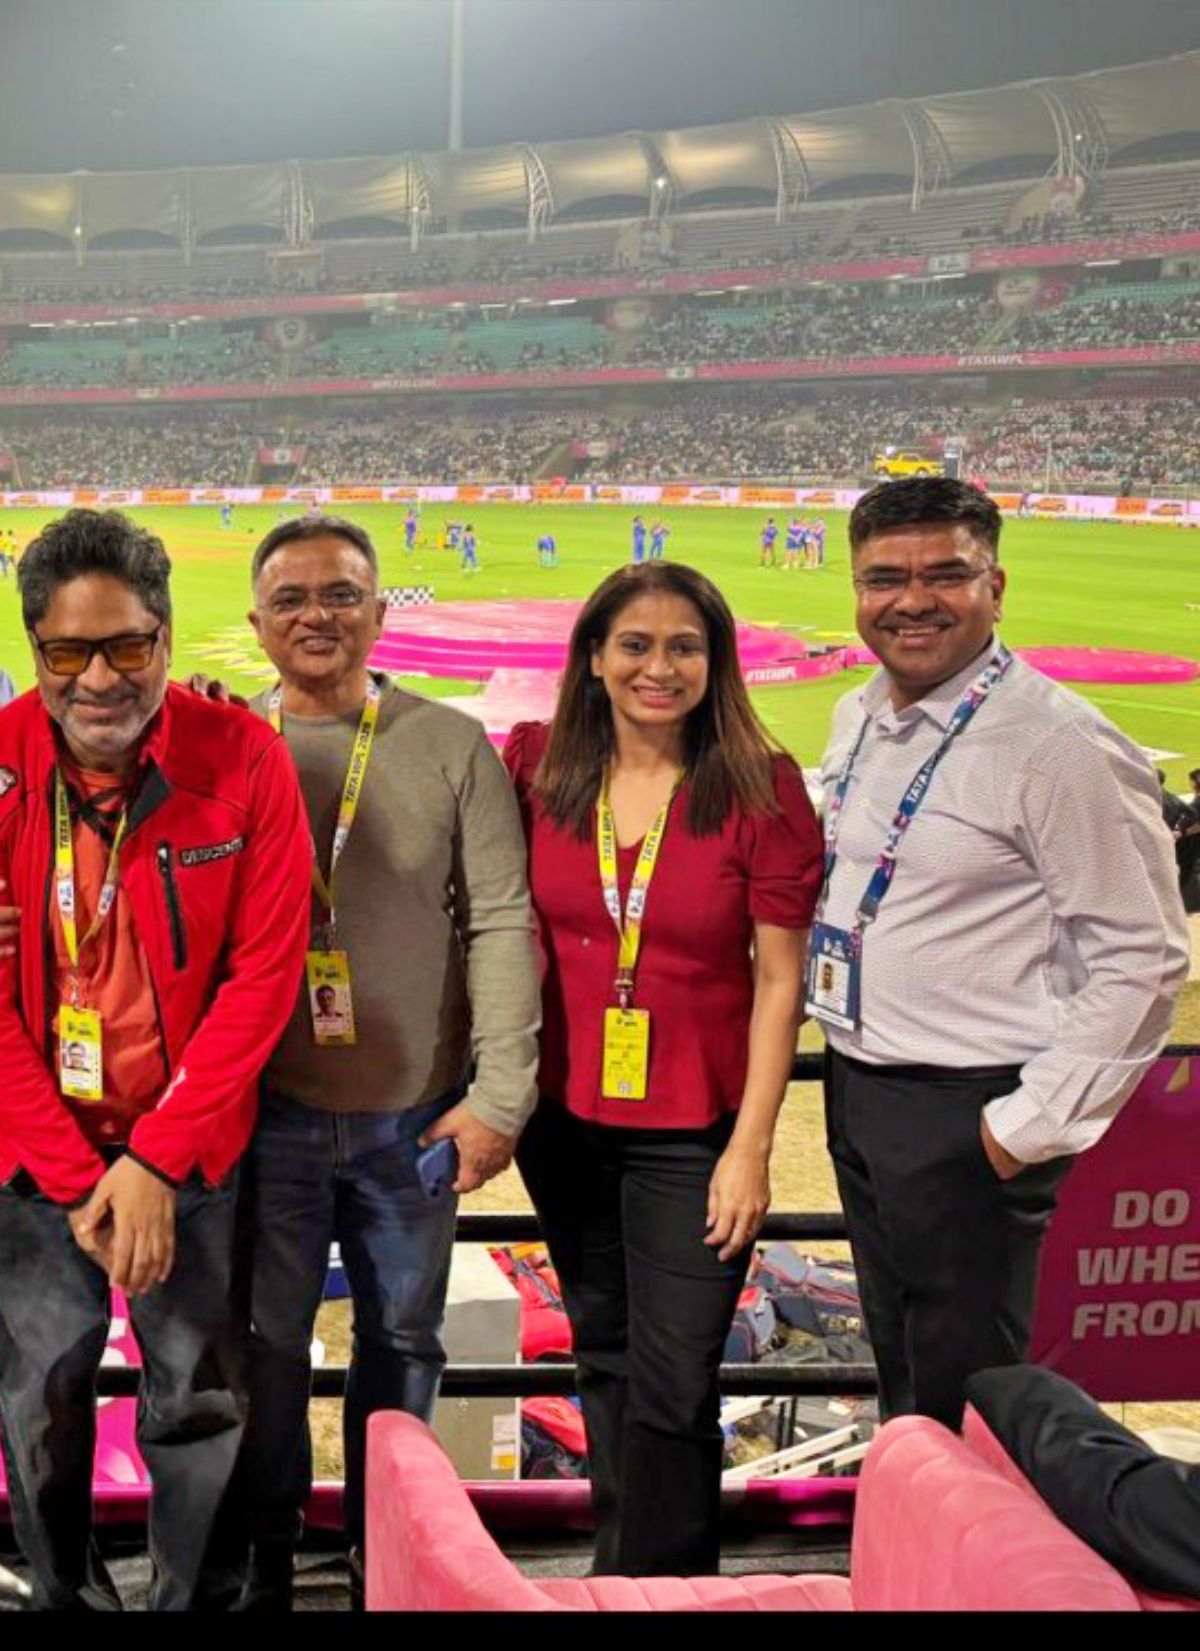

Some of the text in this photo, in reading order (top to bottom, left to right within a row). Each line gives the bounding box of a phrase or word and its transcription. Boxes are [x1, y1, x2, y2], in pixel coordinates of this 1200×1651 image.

[905, 772, 929, 803] TATA
[58, 819, 68, 848] TATA
[641, 833, 658, 862] TATA
[1112, 1188, 1191, 1229] DO
[1076, 1243, 1200, 1287] WHE
